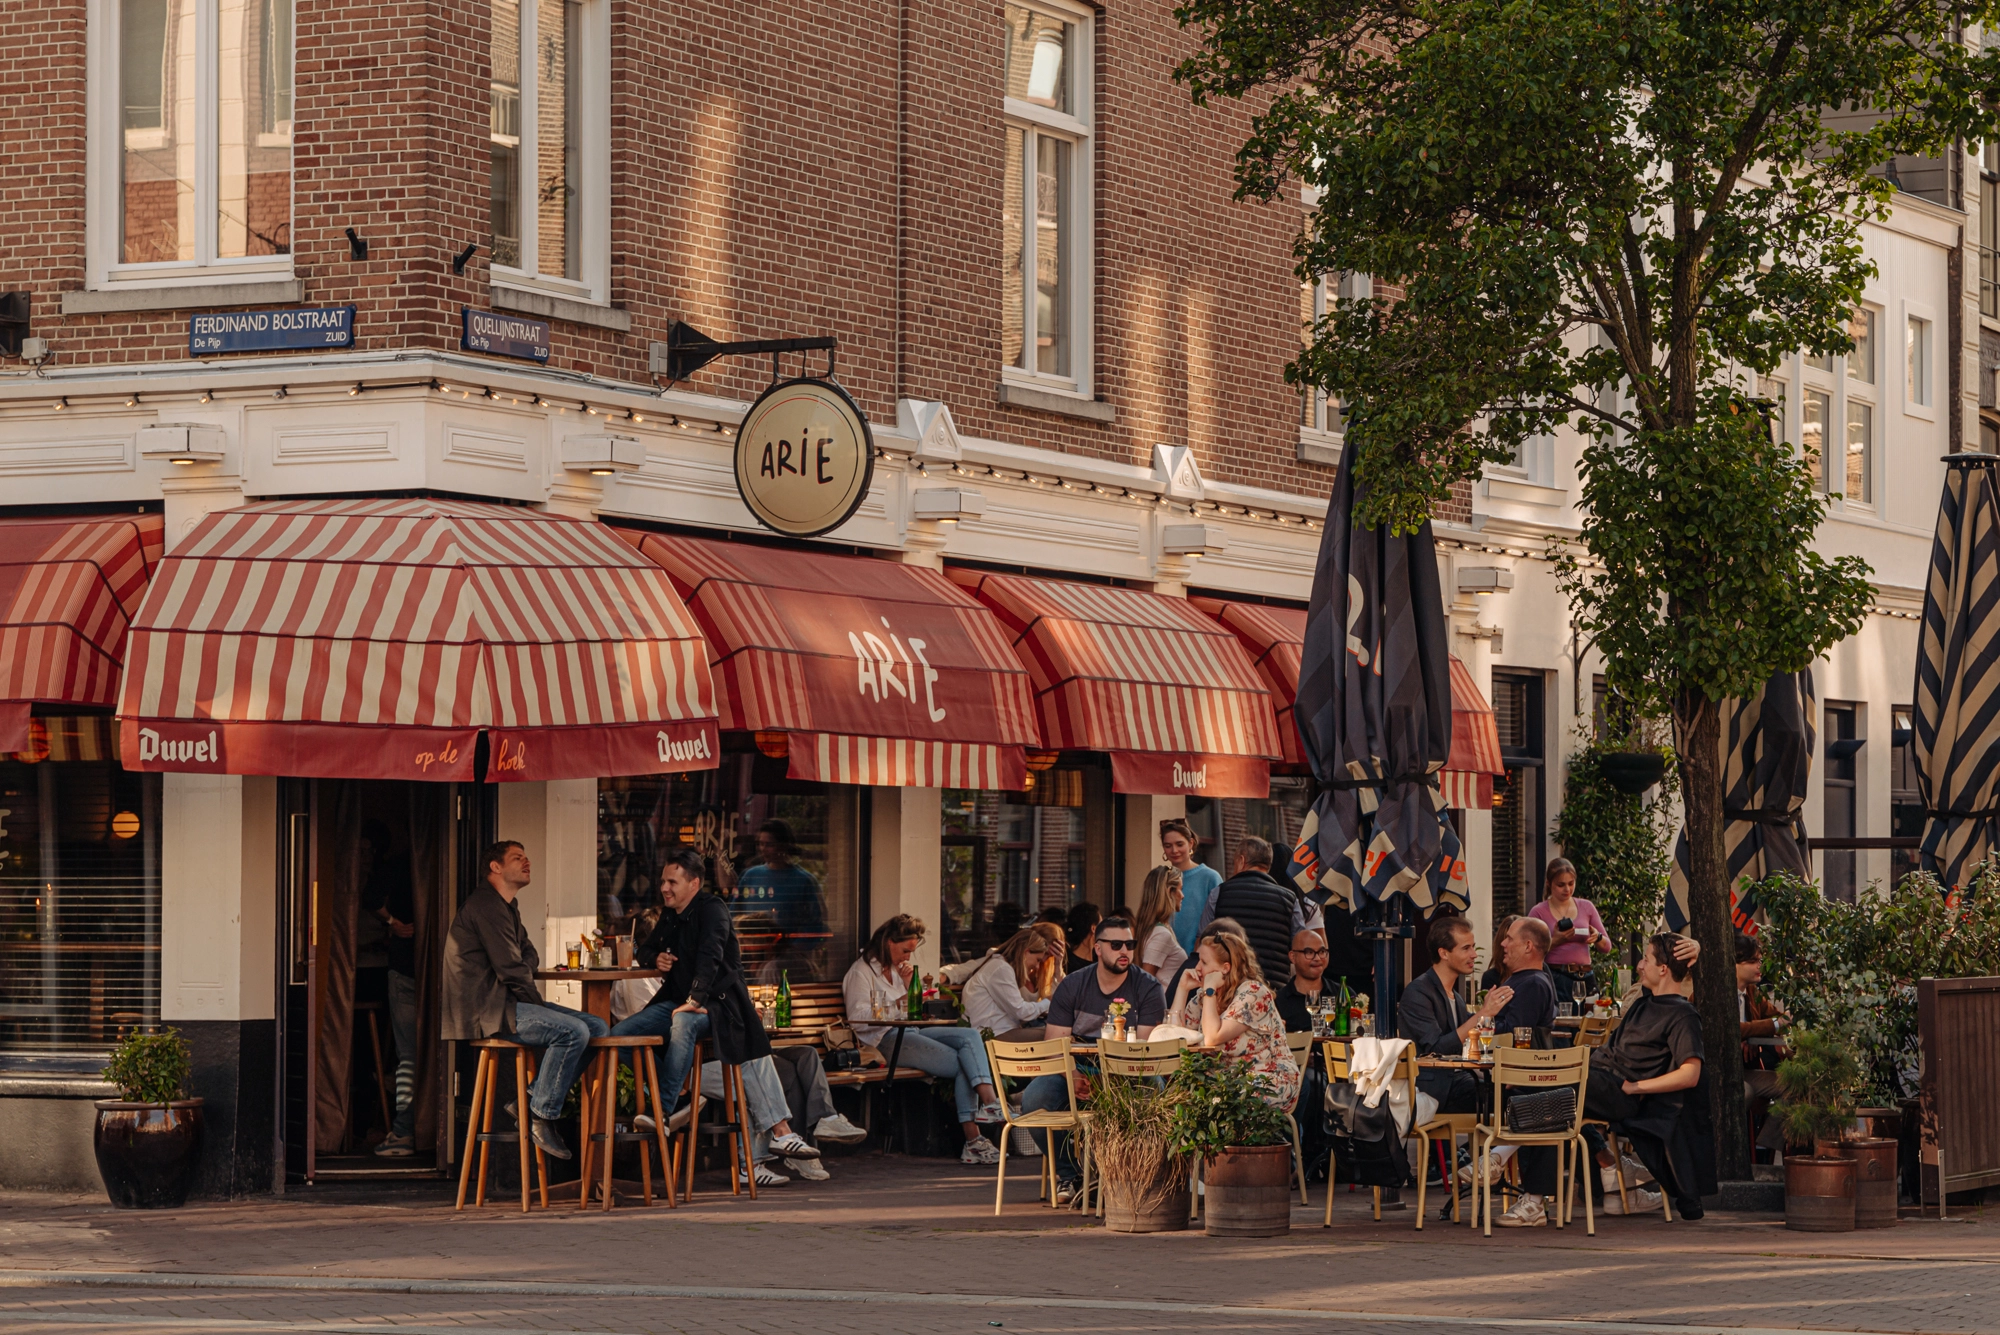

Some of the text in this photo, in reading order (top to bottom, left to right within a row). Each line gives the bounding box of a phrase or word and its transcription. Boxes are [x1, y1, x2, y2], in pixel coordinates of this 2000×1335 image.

[195, 310, 346, 334] FERDINAND BOLSTRAAT
[473, 315, 541, 343] QUELLIJNSTRAAT
[194, 337, 221, 350] De Pijp
[325, 331, 347, 342] ZUID
[470, 336, 490, 350] De Pijp
[533, 346, 548, 358] ZUID
[139, 727, 219, 763] Duvel
[415, 738, 526, 773] op de hoek
[656, 728, 712, 763] Duvel
[1172, 760, 1207, 789] Duvel
